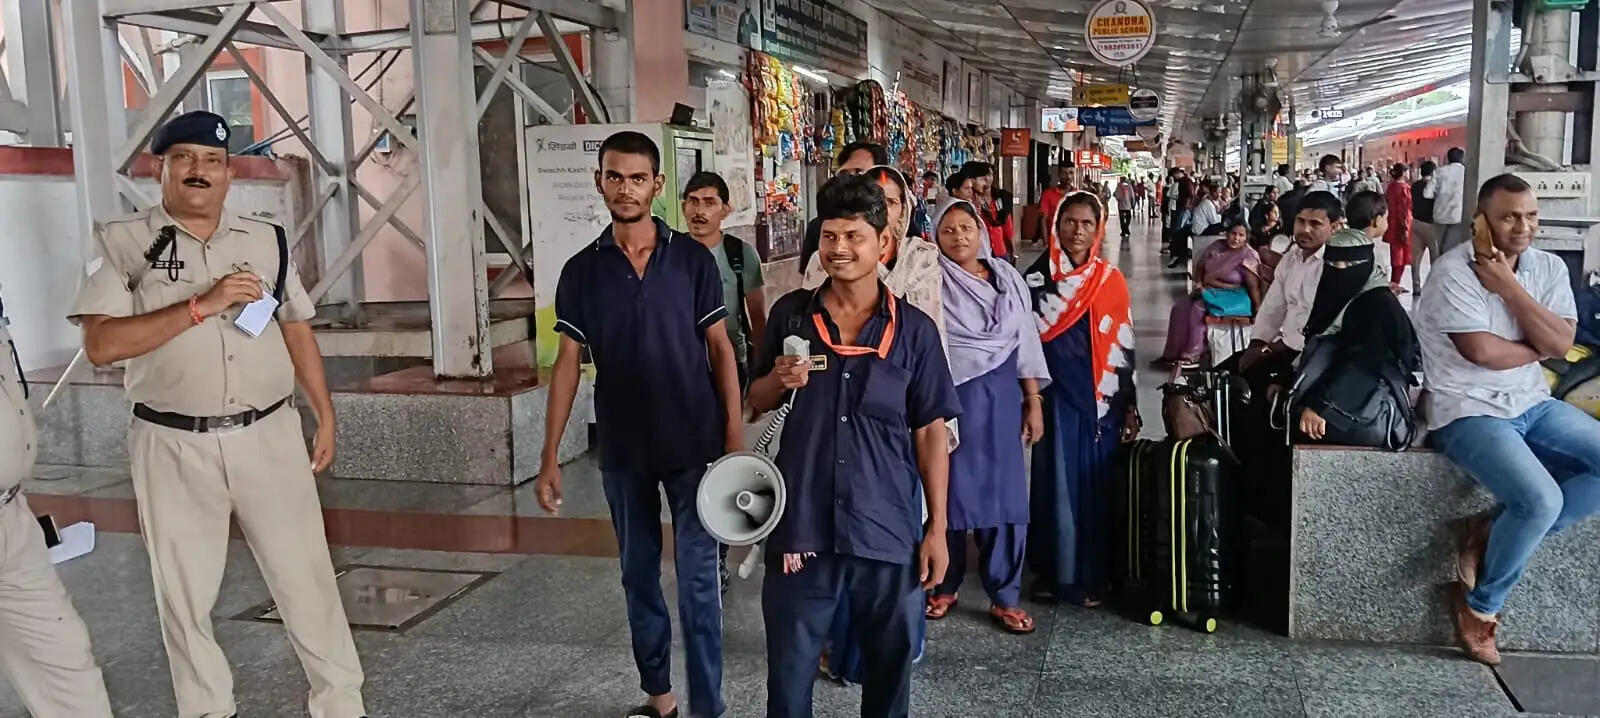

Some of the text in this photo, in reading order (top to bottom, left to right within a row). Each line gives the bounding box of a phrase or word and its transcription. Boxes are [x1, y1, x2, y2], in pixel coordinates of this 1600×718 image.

[1096, 16, 1145, 27] CHANDRA
[1119, 26, 1148, 34] SCHOOL
[584, 141, 602, 151] DIC
